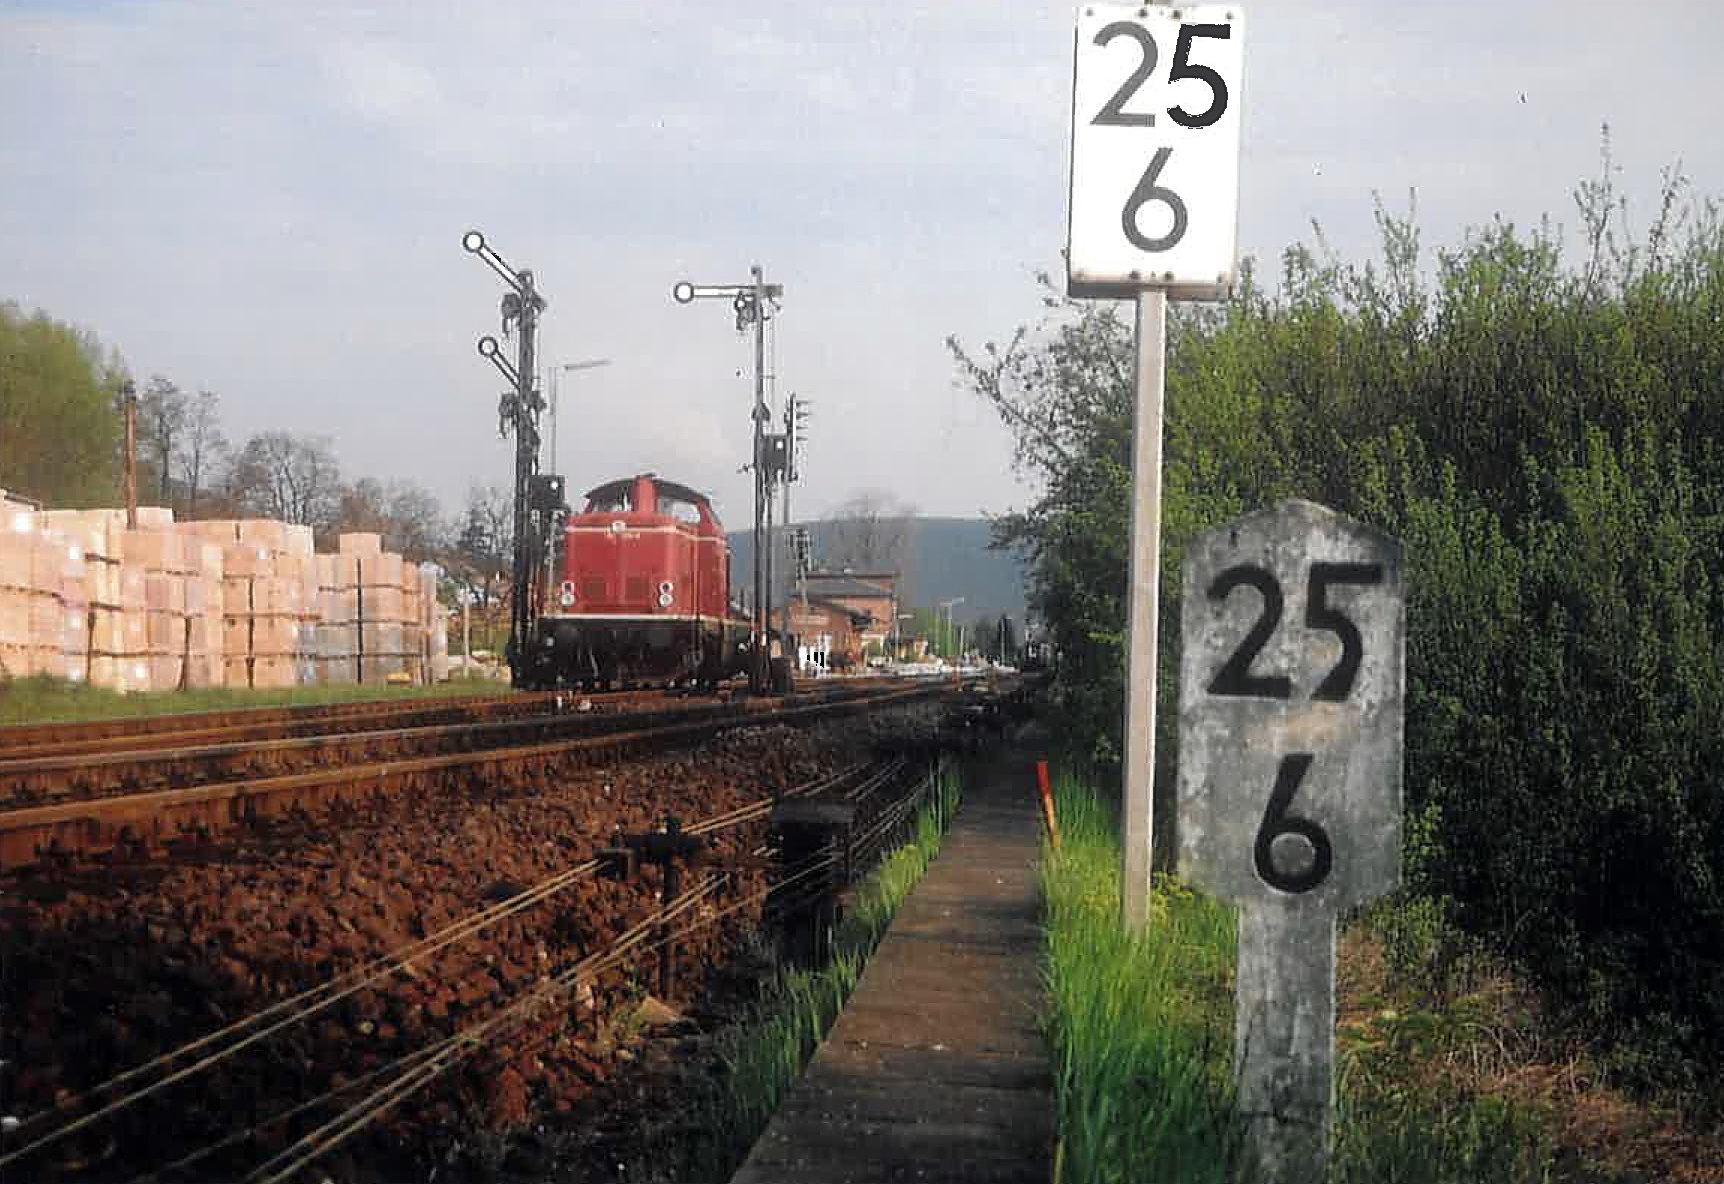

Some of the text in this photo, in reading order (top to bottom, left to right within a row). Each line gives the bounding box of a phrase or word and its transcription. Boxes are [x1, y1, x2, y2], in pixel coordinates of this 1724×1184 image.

[1090, 21, 1230, 129] 25
[1121, 147, 1188, 253] 6
[1206, 562, 1383, 703] 25
[1254, 753, 1333, 893] 6
